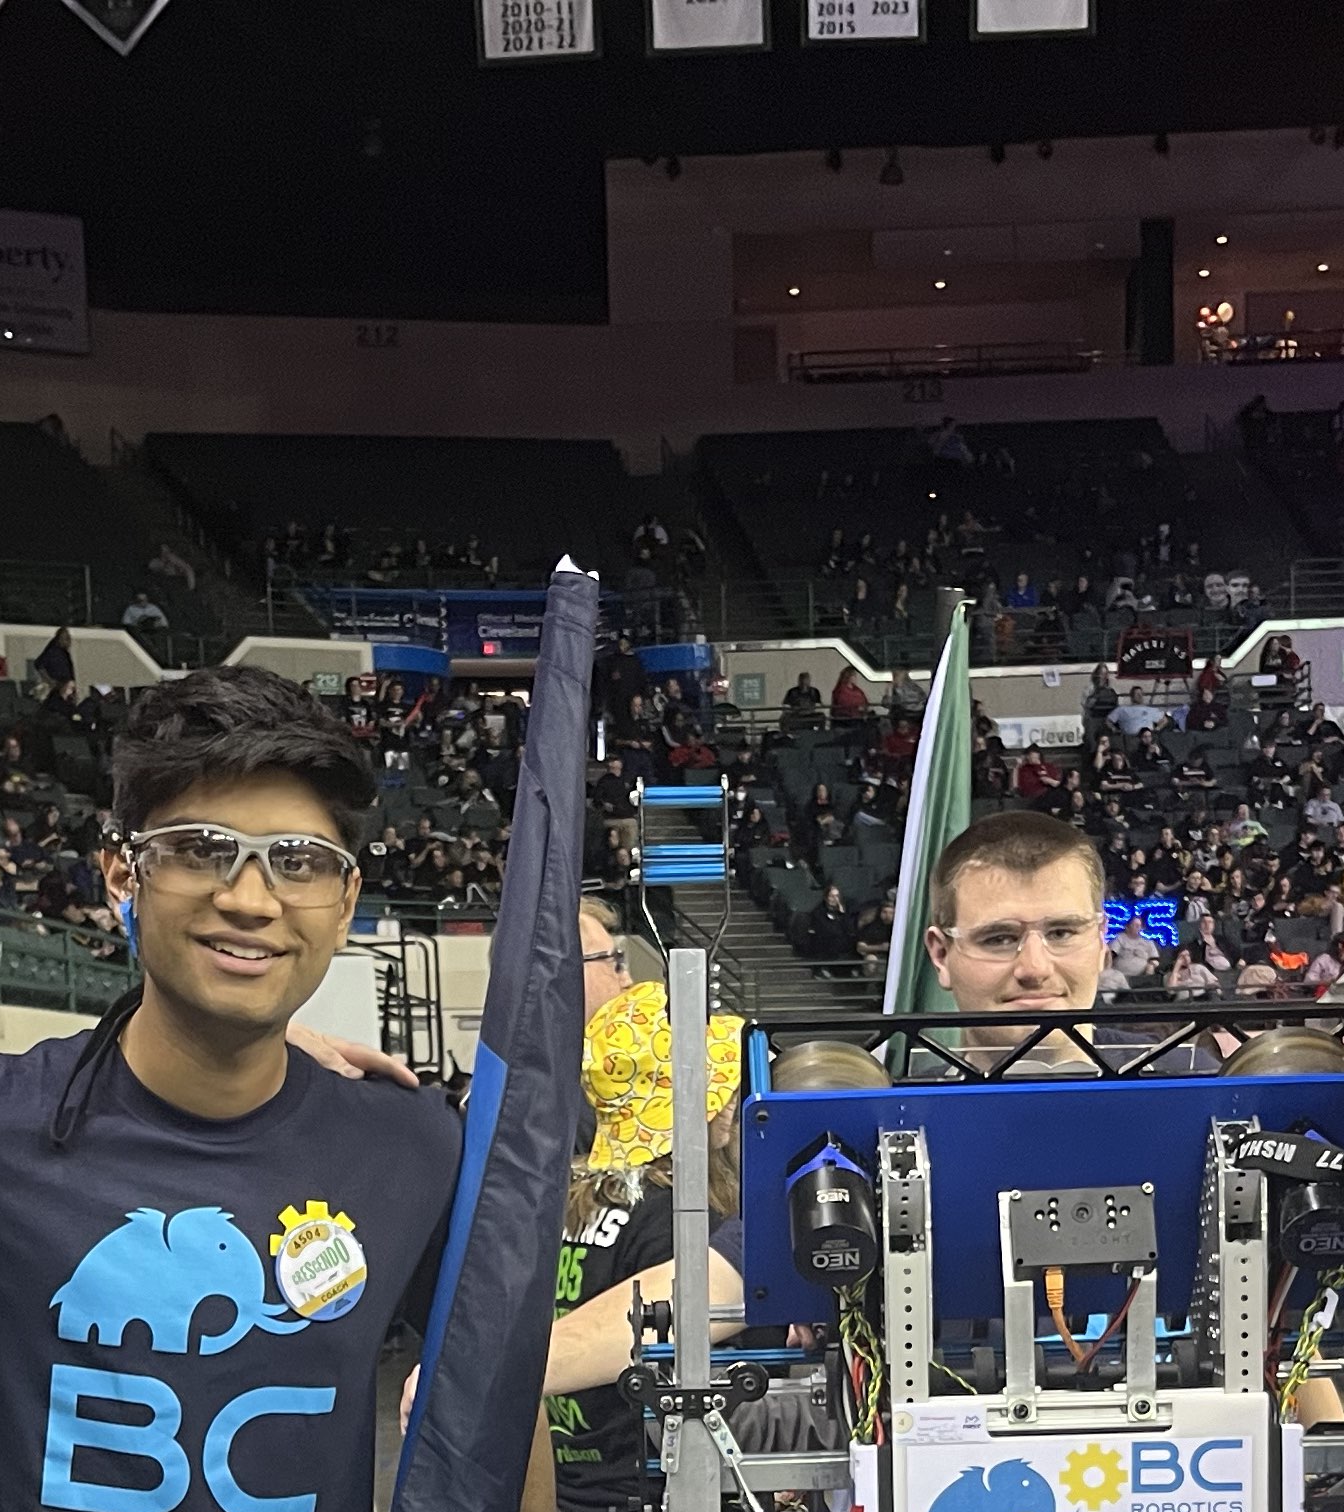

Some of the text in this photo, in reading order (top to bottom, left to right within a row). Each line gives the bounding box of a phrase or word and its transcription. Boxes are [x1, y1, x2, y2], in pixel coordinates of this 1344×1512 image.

[501, 18, 576, 36] 2020-21
[817, 19, 857, 35] 2015
[501, 33, 577, 53] 2021-22
[1028, 727, 1084, 745] Clevel
[1239, 1139, 1297, 1164] MSHA
[816, 1190, 850, 1203] NEO
[292, 1227, 322, 1250] 4504
[291, 1236, 351, 1286] CRESCENDO
[811, 1251, 860, 1269] NEO
[320, 1280, 349, 1303] COACH
[1130, 1438, 1244, 1494] BC
